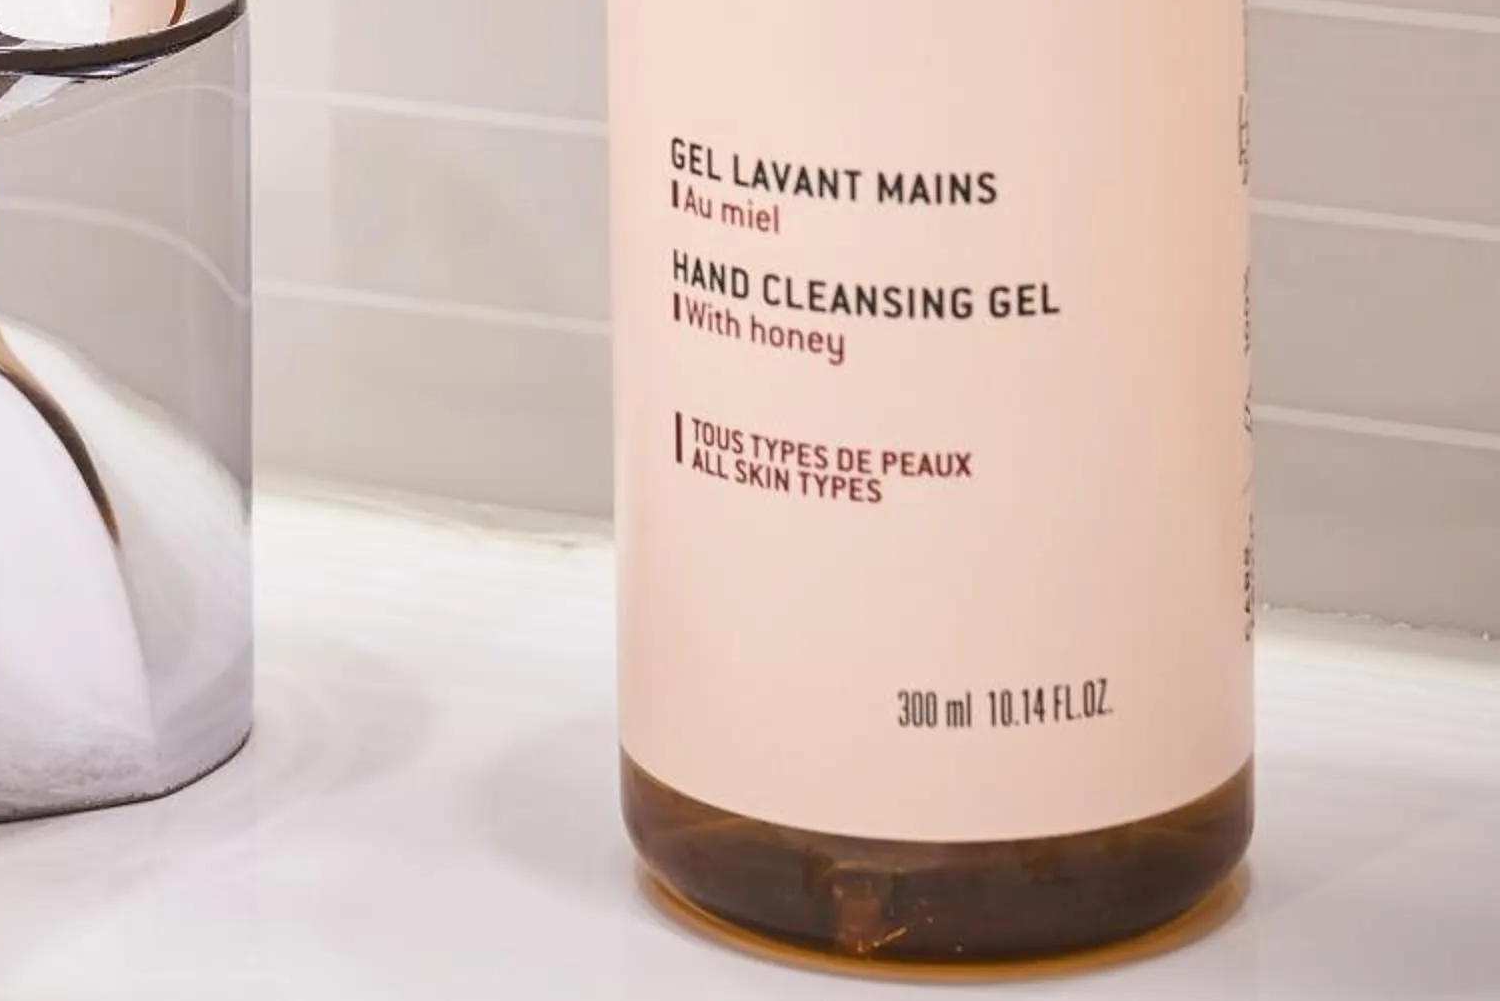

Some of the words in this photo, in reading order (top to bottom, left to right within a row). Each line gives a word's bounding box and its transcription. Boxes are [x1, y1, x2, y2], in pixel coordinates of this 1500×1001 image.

[671, 137, 722, 182] GEL
[732, 153, 862, 201] LAVANT
[877, 171, 998, 206] MAINS
[683, 185, 713, 220] Au
[721, 202, 781, 234] miel
[672, 248, 750, 300] HAND
[762, 274, 973, 320] CLEANSING
[988, 282, 1061, 318] GEL
[685, 296, 741, 339] With
[750, 314, 845, 366] honey
[691, 417, 744, 454] TOUS
[750, 433, 829, 471] TYPES
[837, 448, 872, 474] DE
[882, 451, 972, 478] PEAUX
[691, 447, 728, 480] ALL
[735, 458, 790, 492] SKIN
[800, 472, 883, 504] TYPES
[897, 690, 938, 728] 300
[945, 690, 972, 728] ml
[988, 686, 1046, 727] 10.14
